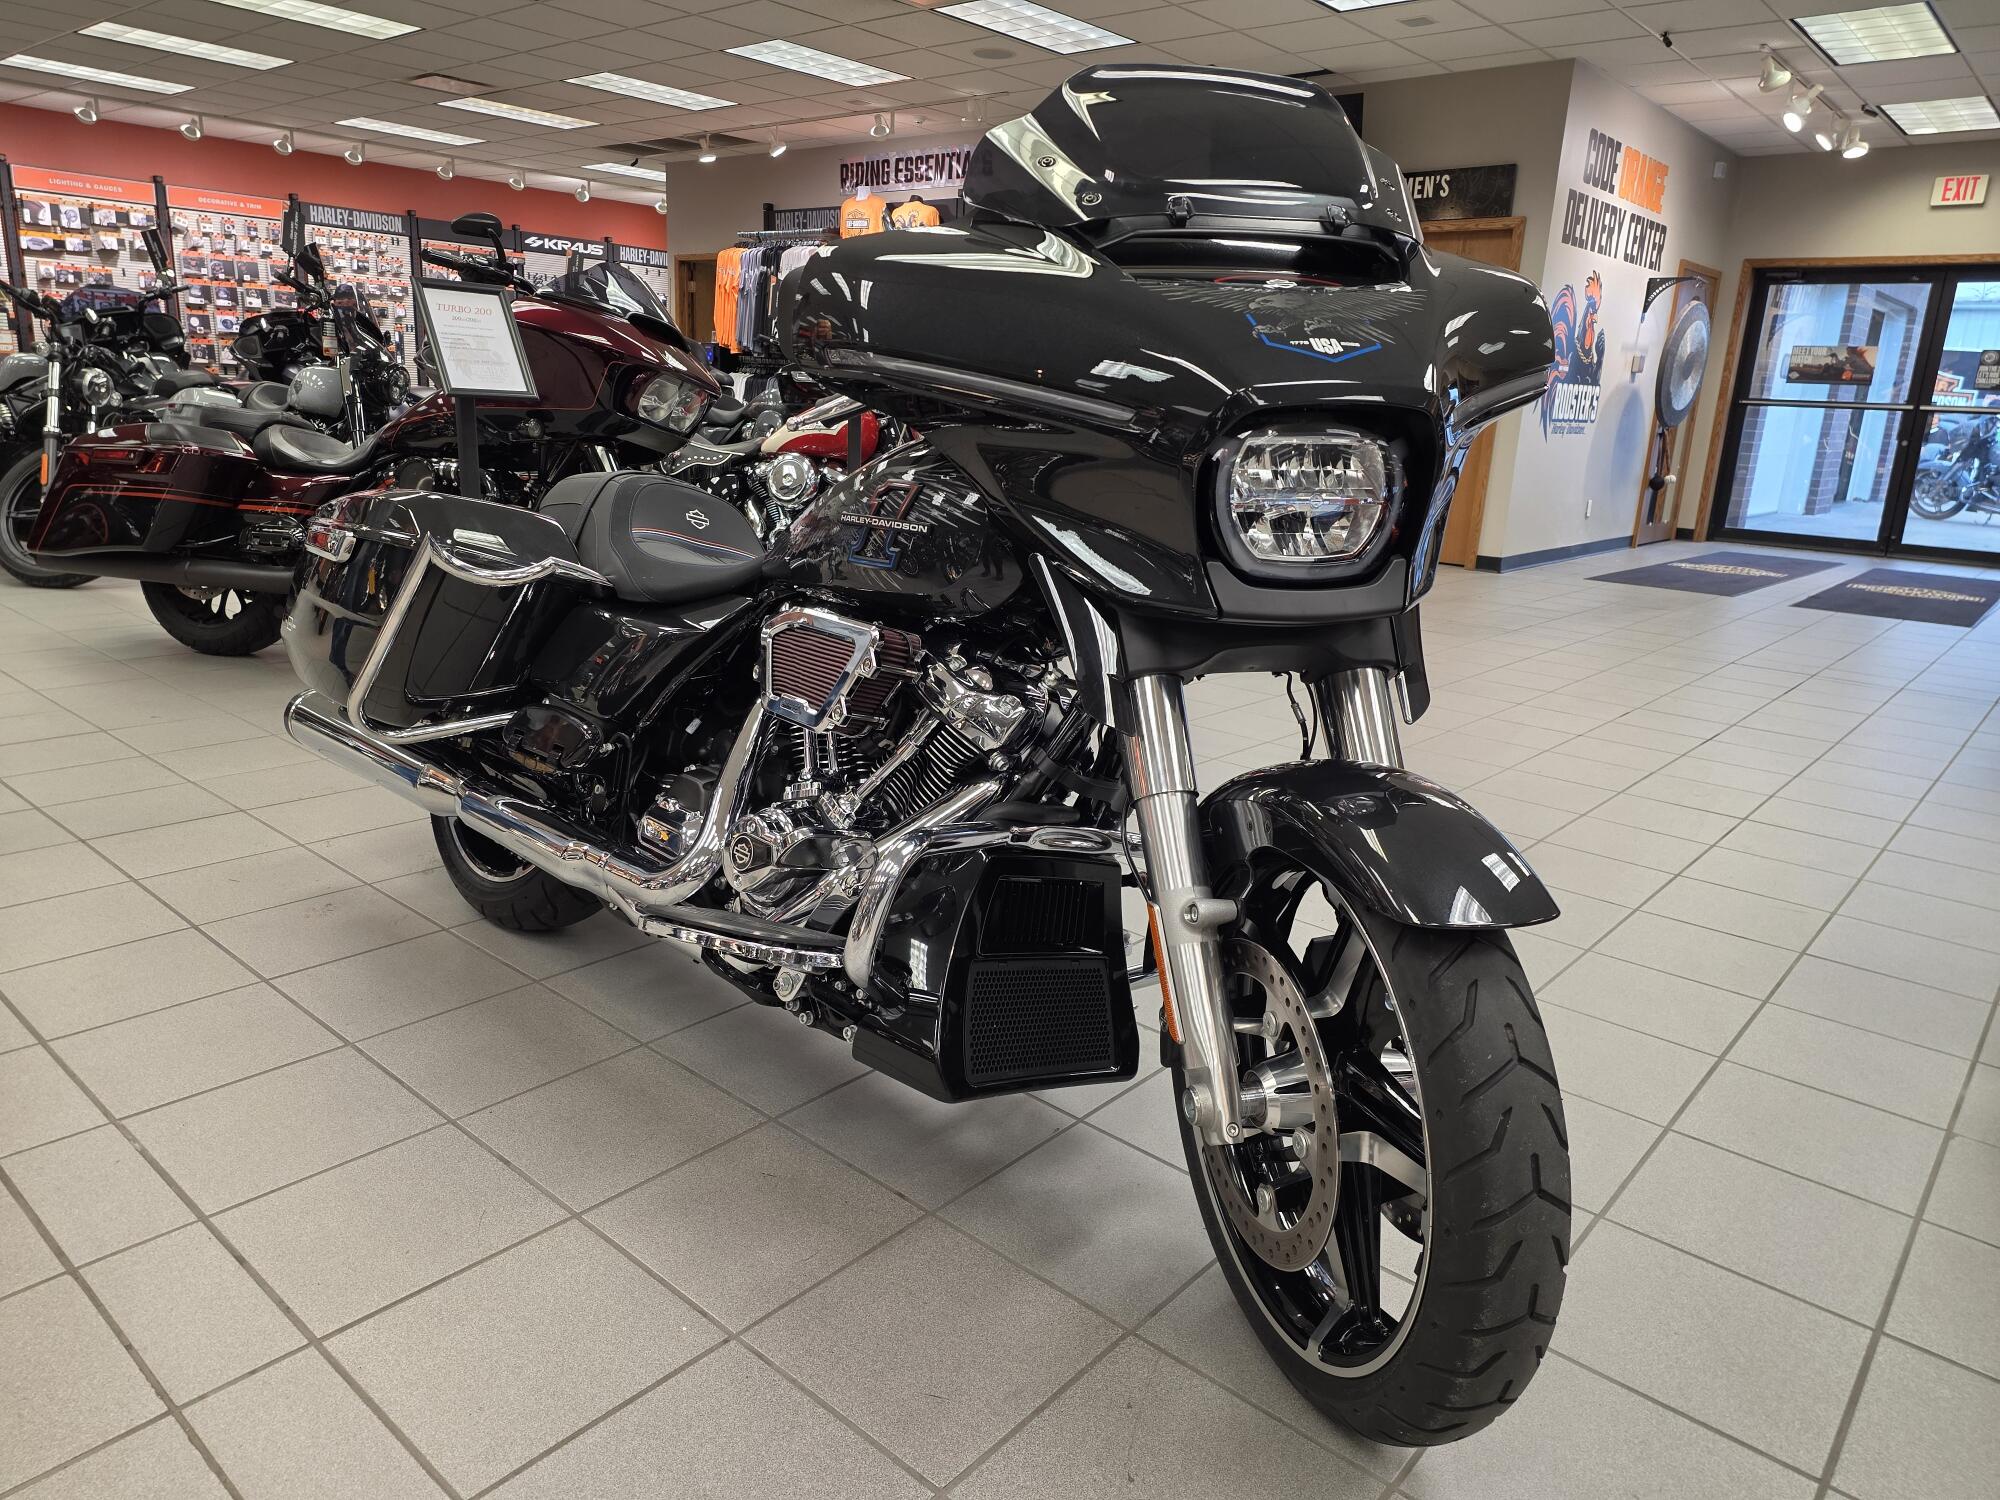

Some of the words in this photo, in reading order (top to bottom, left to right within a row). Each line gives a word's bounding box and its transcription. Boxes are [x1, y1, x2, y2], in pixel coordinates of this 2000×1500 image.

[840, 159, 891, 190] RIDING
[894, 150, 972, 184] ESSENTIA
[1583, 128, 1622, 194] CODE
[1618, 145, 1669, 214] ORANGE
[48, 178, 82, 188] LIGHTING
[93, 185, 123, 193] GAUGES
[1941, 176, 1981, 201] EXIT
[198, 197, 238, 207] DECORATIVE
[309, 204, 402, 233] HARLEY-DAVIDSON
[775, 209, 841, 231] HARLEY-DAVIDSO
[1561, 188, 1627, 259] DELIVERY
[1623, 212, 1667, 272] CENTER
[544, 238, 604, 256] KRAUS
[619, 246, 668, 267] HARLEY-DAVI
[436, 303, 472, 314] TURBO
[475, 308, 493, 316] 200
[1309, 338, 1344, 354] USA
[1552, 383, 1600, 422] ROOSTER'S
[841, 514, 928, 533] HARLEY-DAVIDSON
